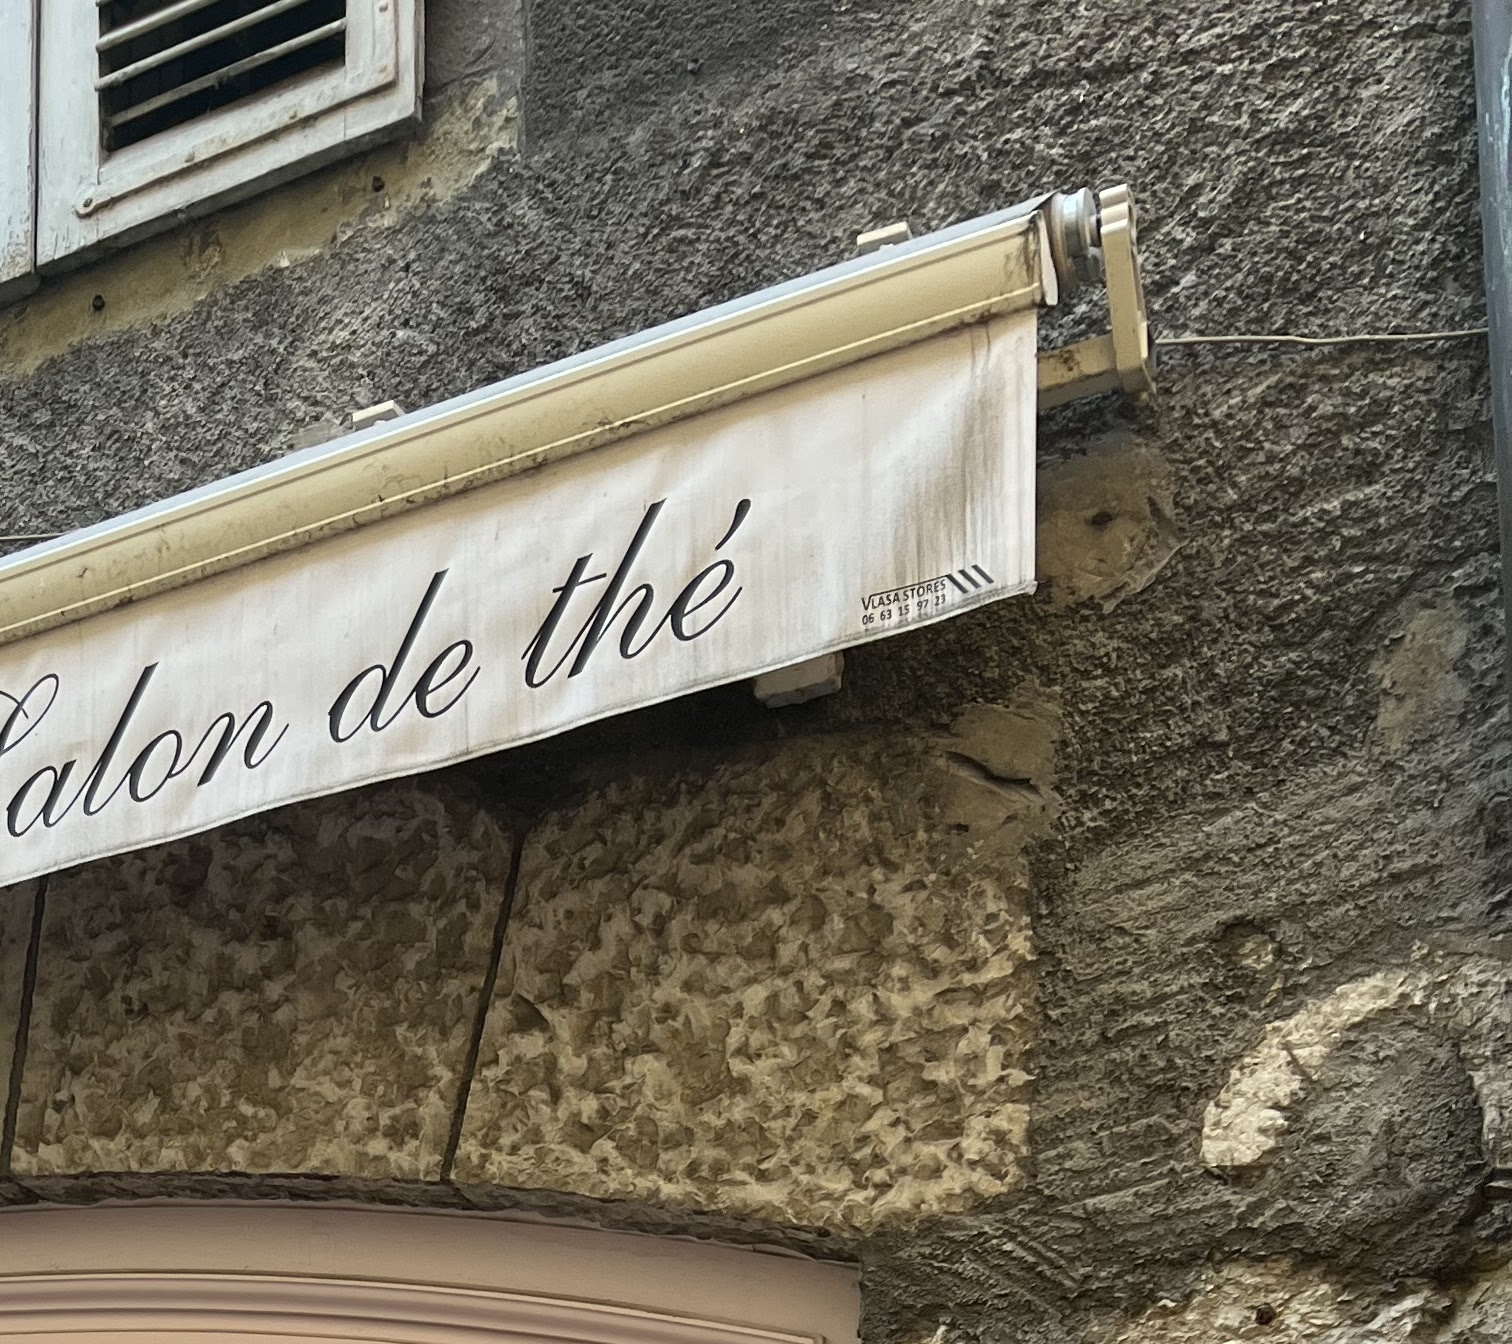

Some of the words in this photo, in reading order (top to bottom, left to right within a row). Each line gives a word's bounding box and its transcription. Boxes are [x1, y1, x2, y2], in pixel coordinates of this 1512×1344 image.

[861, 592, 901, 611] VLASA
[902, 579, 946, 603] STORES
[862, 613, 875, 625] 06
[880, 609, 892, 621] 63
[898, 604, 910, 617] 15
[916, 598, 929, 612] 97
[934, 593, 946, 607] 23
[328, 567, 480, 744] de
[521, 498, 752, 690] thé
